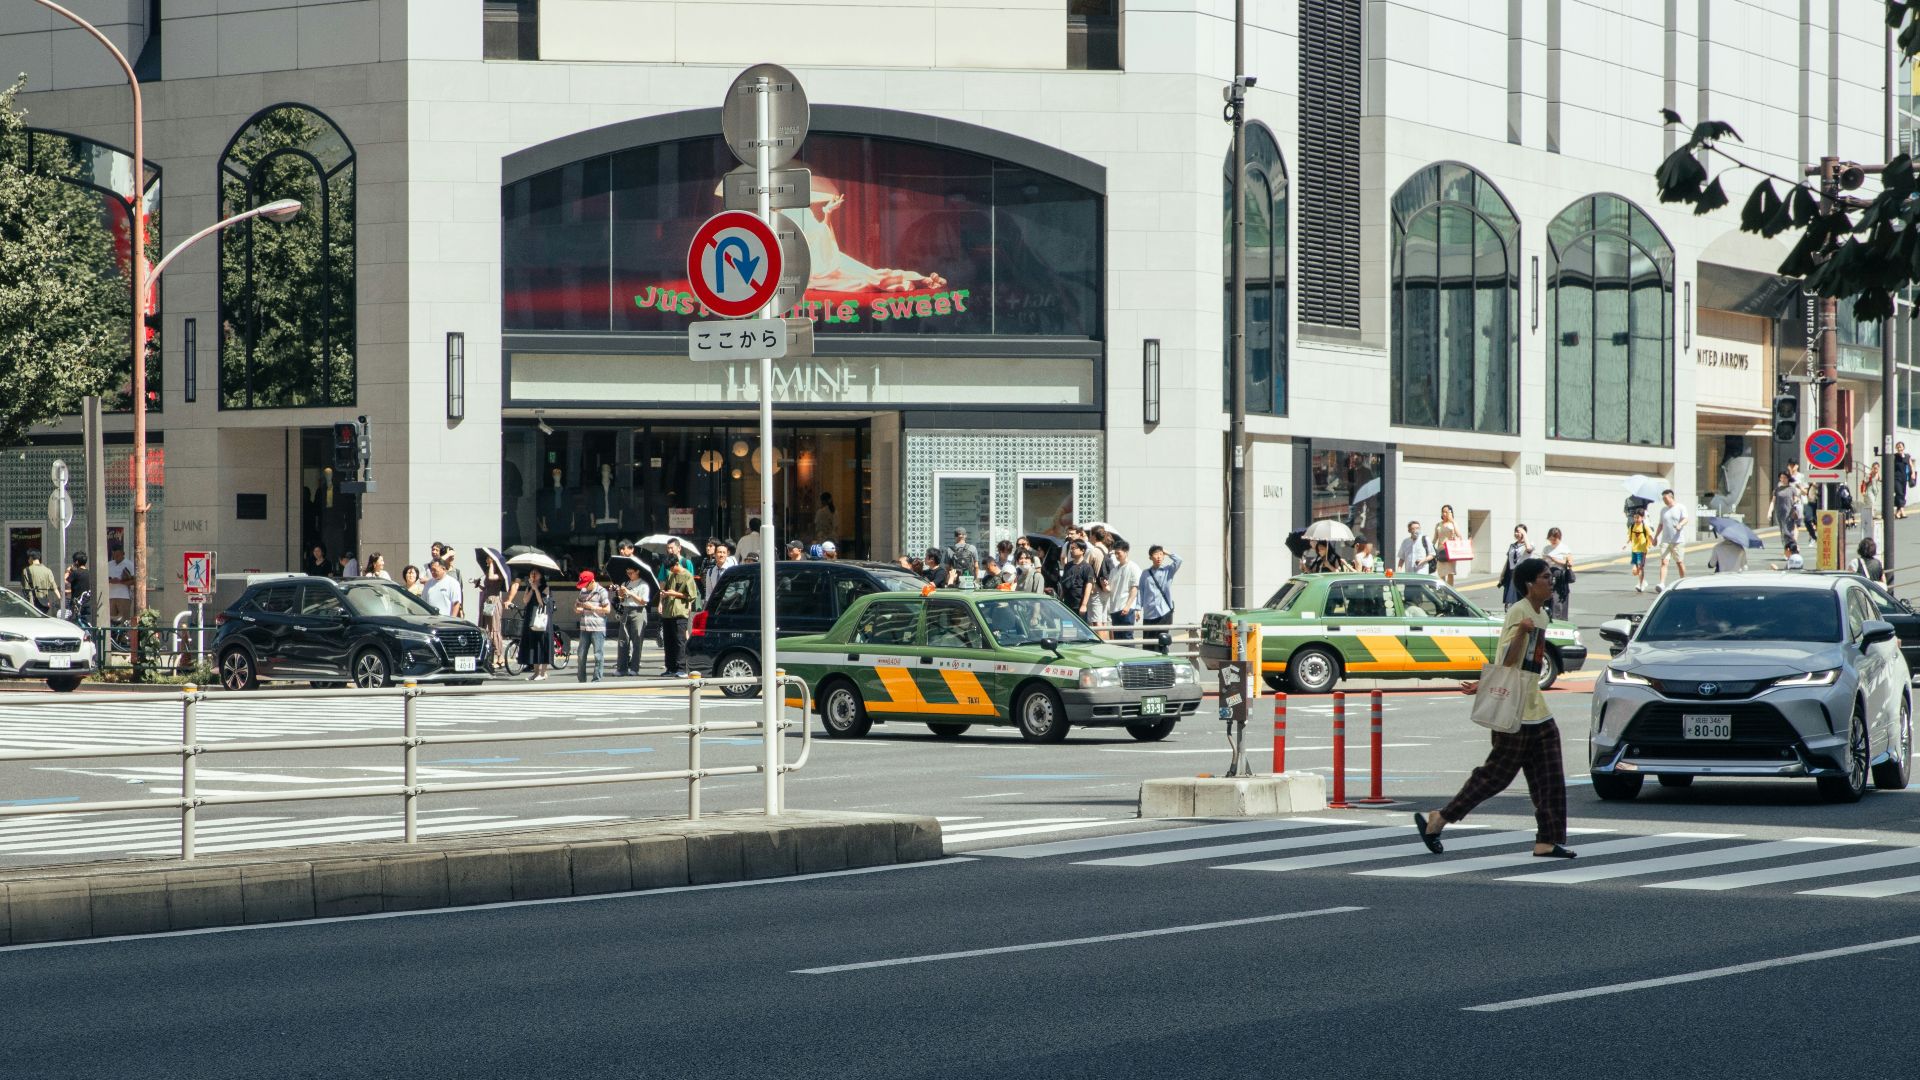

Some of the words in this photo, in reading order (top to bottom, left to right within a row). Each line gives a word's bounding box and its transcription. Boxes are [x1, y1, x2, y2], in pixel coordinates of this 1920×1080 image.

[1806, 299, 1815, 334] UNITED
[697, 329, 777, 350] ここから
[1696, 348, 1718, 367] NITED
[1720, 351, 1749, 371] ARROWS
[173, 519, 202, 531] LUMINE
[967, 696, 980, 704] TAXI
[1694, 725, 1729, 737] 80-00
